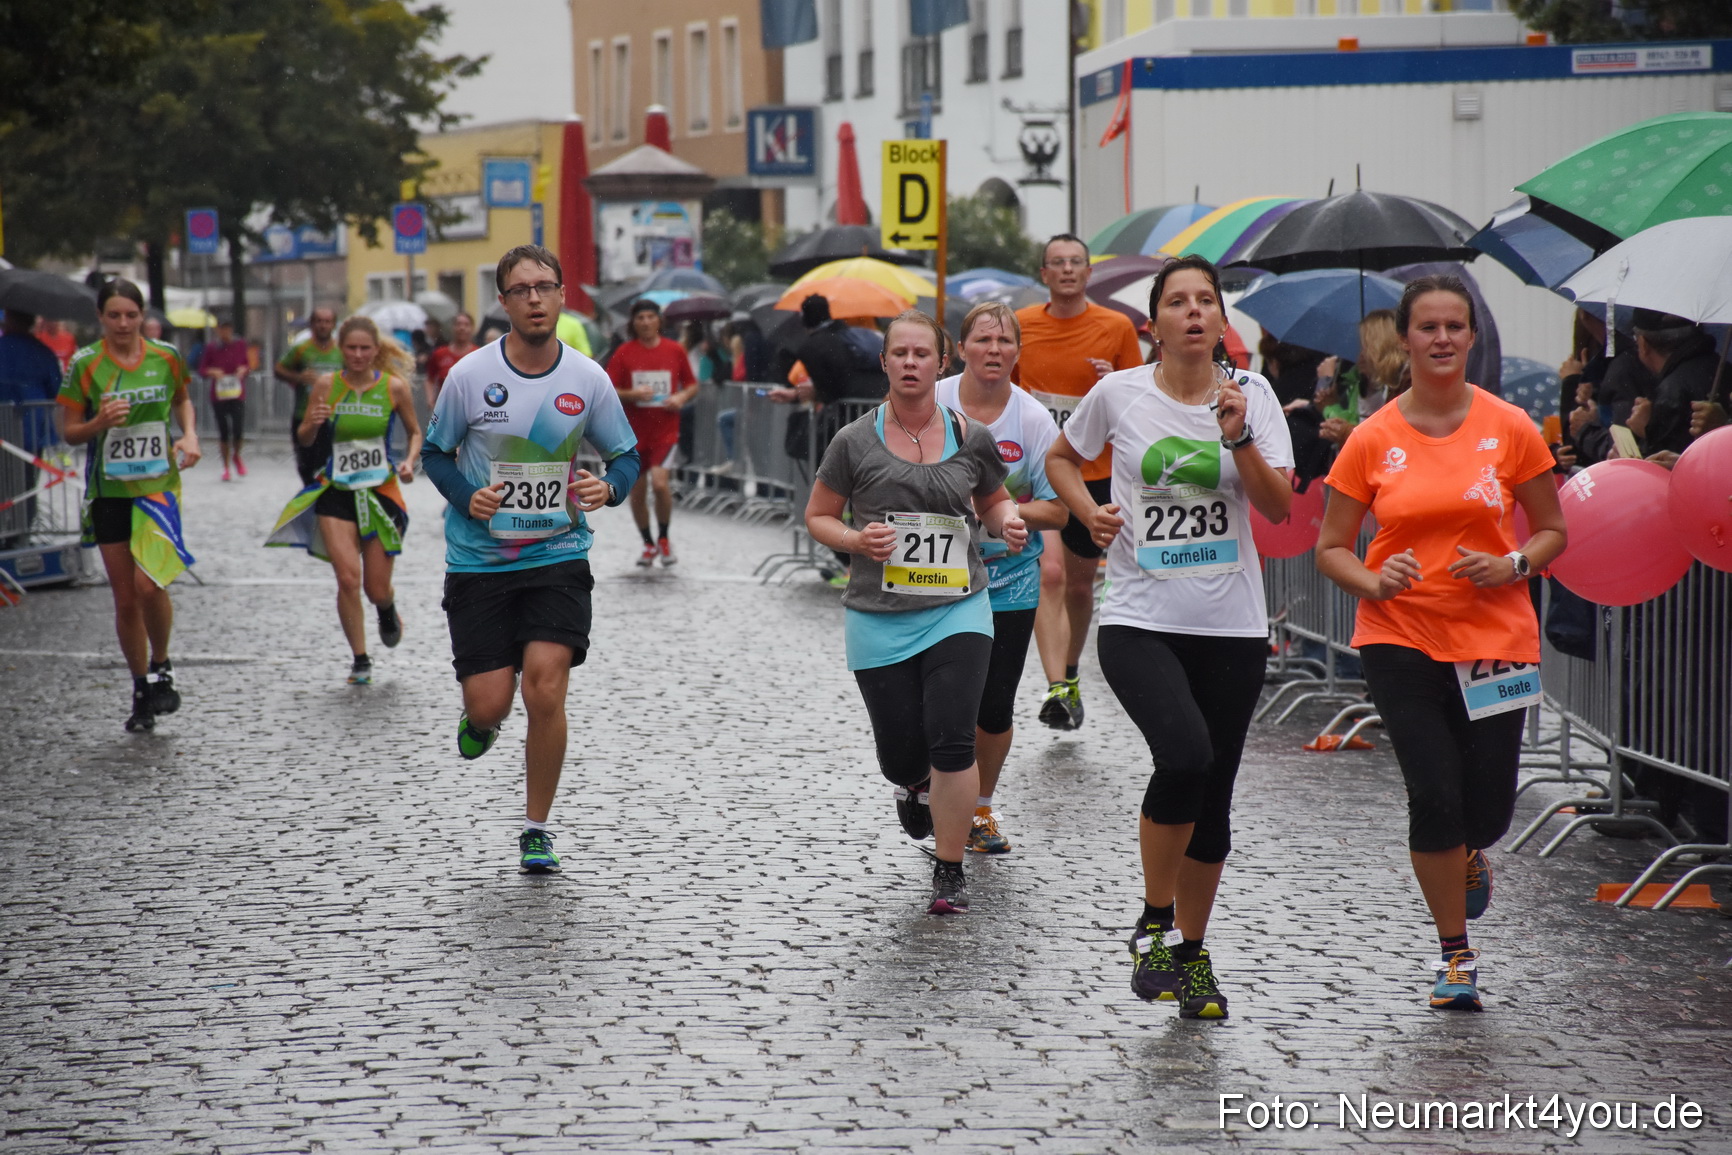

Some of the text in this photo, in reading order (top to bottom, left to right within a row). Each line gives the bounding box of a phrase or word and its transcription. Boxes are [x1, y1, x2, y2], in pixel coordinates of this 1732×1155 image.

[890, 145, 940, 163] Block
[899, 173, 930, 224] D
[335, 402, 383, 417] BOCK
[559, 398, 582, 411] Hervis
[110, 437, 161, 459] 2878
[997, 444, 1020, 458] Hervis
[339, 449, 381, 472] 2830
[528, 464, 563, 475] BOCK
[500, 480, 562, 510] 2382
[511, 517, 554, 529] Thomas
[926, 516, 965, 529] BOCK
[1145, 501, 1229, 541] 2233
[546, 541, 578, 551] Stadtlauf
[903, 532, 954, 564] 217
[1161, 547, 1217, 565] Cornelia
[908, 571, 948, 584] Kerstin
[1471, 659, 1537, 682] 22
[1498, 680, 1532, 699] Beate
